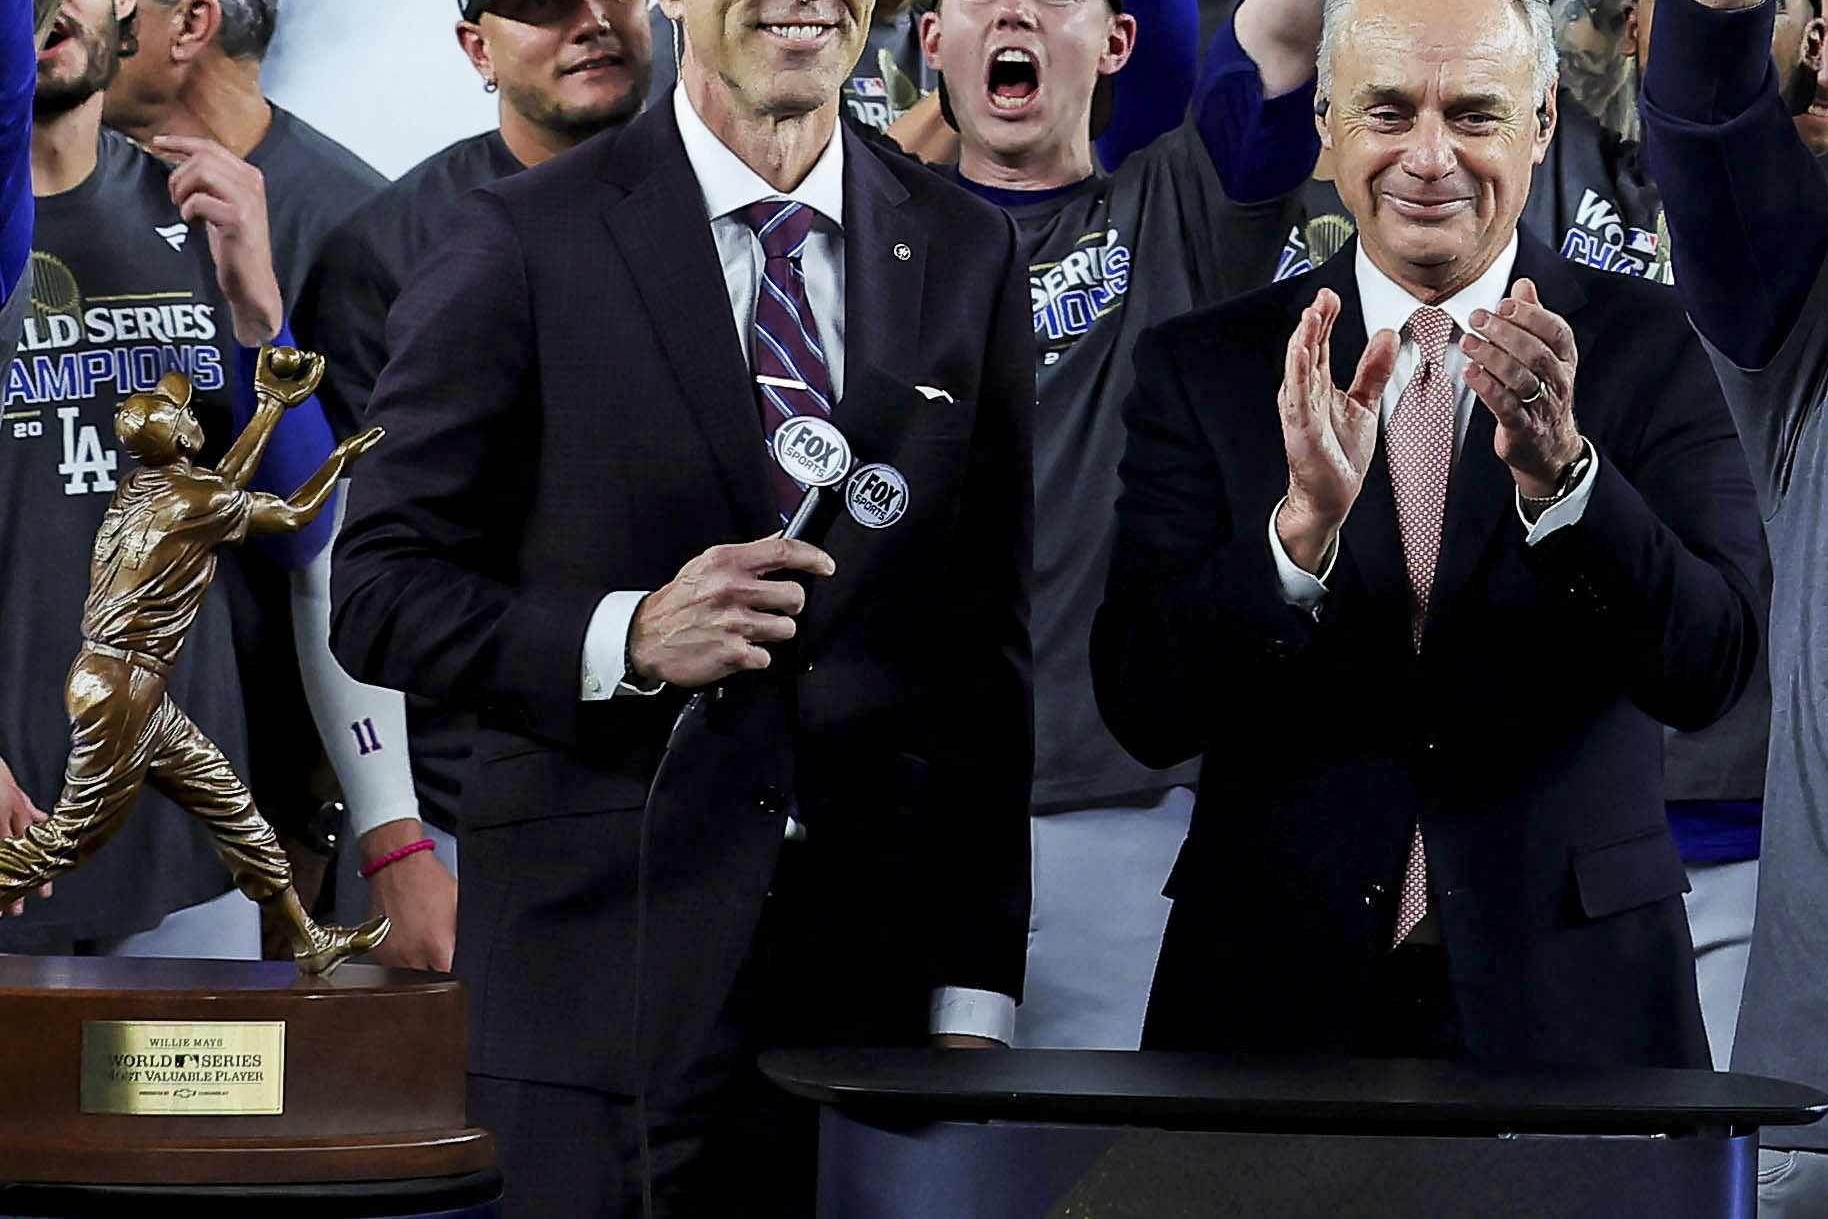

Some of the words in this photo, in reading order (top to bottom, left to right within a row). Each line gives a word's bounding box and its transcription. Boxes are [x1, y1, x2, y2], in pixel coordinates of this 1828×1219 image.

[17, 314, 82, 352] LD
[84, 304, 217, 344] SERIES
[4, 345, 225, 406] AMPIONS
[13, 421, 43, 438] 20
[791, 426, 840, 469] FOX
[57, 406, 118, 496] LA
[784, 447, 827, 478] SPORTS
[853, 494, 888, 520] SPORTS
[859, 473, 902, 512] FOX
[351, 717, 383, 755] 11
[111, 1054, 173, 1068] WORLD
[202, 1054, 262, 1068] SERIES
[150, 1038, 190, 1047] WILLIE
[193, 1038, 224, 1047] MAYS
